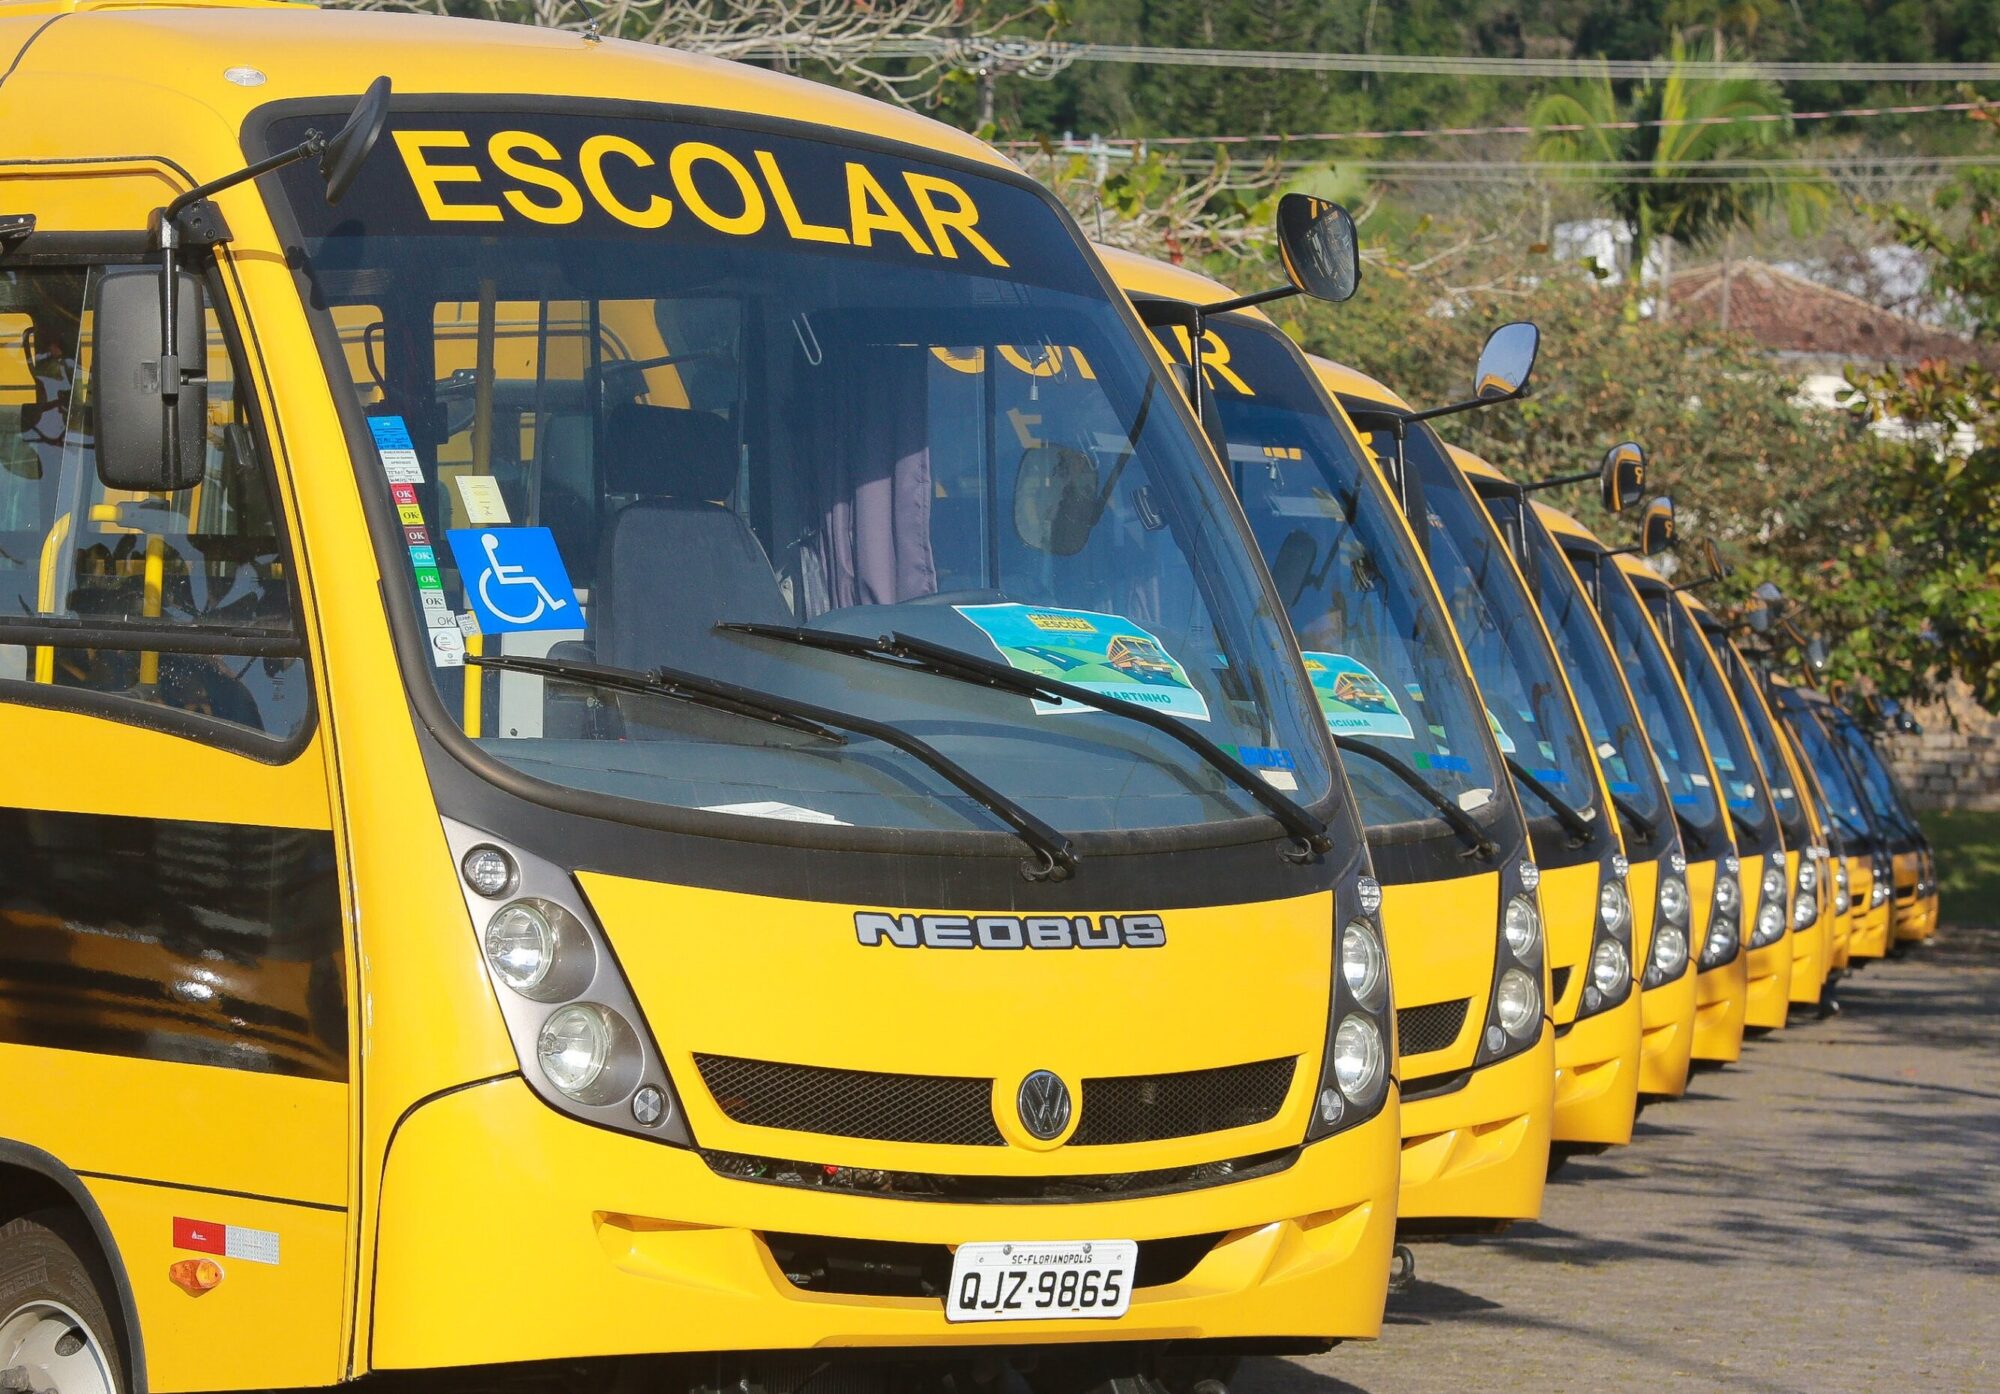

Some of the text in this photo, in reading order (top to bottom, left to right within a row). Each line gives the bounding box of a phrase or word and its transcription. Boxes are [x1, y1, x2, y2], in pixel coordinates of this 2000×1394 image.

[391, 130, 1011, 268] ESCOLAR
[396, 490, 412, 498] OK
[408, 532, 425, 540] OK
[420, 575, 436, 583] OK
[437, 616, 455, 626] OK
[854, 911, 1167, 950] NEOBUS
